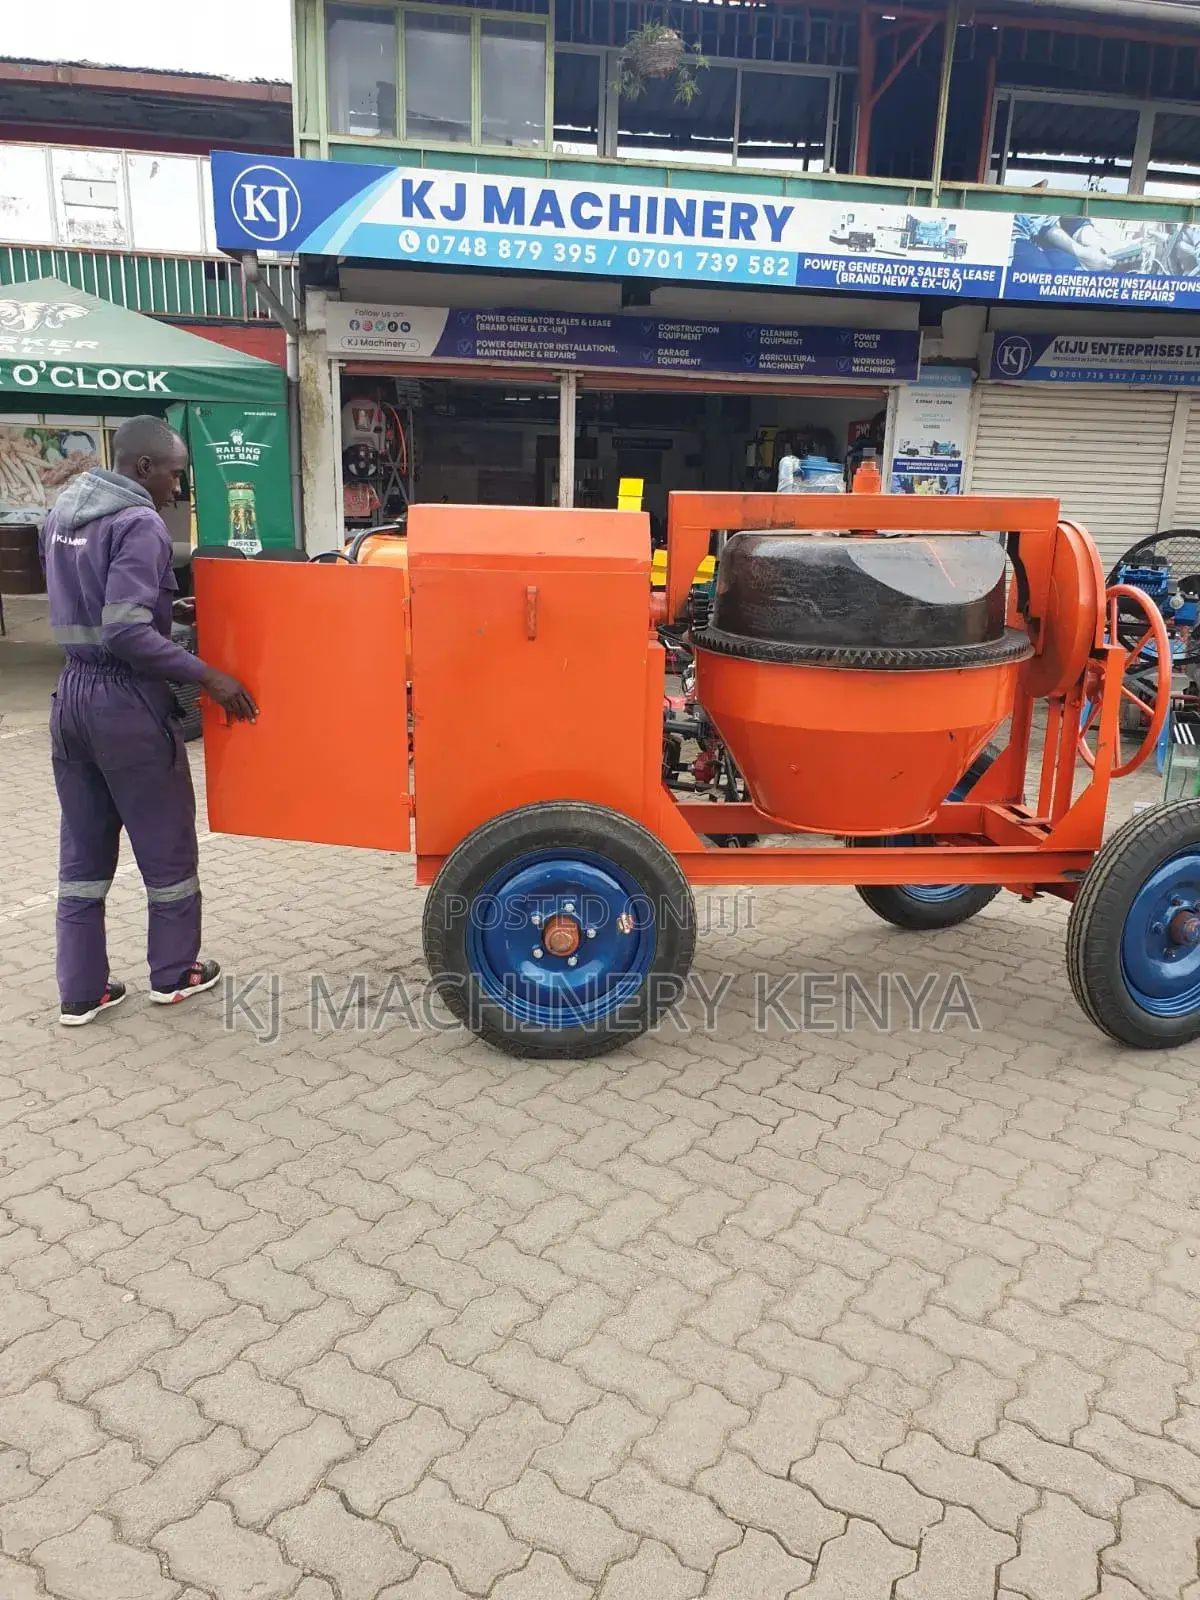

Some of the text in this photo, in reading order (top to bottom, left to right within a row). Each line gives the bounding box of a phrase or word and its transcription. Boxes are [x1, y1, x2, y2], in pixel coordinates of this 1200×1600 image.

[240, 183, 290, 241] KJ
[401, 178, 796, 243] KJ MACHINERY
[426, 235, 790, 277] 0748 879 395 / 0701 739 582
[803, 258, 996, 282] POWER GENERATOR SALES & LEASE
[836, 270, 963, 293] (BRAND NEW & EX-UK)
[1012, 271, 1053, 285] POWER
[1054, 274, 1119, 289] GENERATOR
[1039, 286, 1176, 303] MAINTENANCE & REPAIRS
[354, 308, 380, 318] Follow
[476, 314, 612, 328] POWER GENERATOR SALES & LEASE
[476, 322, 568, 336] (BRAND NEW & EX-UK)
[658, 323, 720, 334] CONSTRUCTION
[760, 329, 799, 338] CLEANING
[658, 332, 703, 341] EQUIPMENT
[759, 337, 804, 346] EQUIPMENT
[853, 332, 882, 342] POWER
[0, 336, 100, 350] SKER
[347, 338, 407, 350] KJ Machinery
[476, 340, 619, 354] POWER GENERATOR INSTALLATIONS,
[853, 340, 879, 349] TOOLS
[0, 344, 72, 356] ALT
[476, 349, 577, 360] MAINTENANCE & REPAIRS
[657, 347, 690, 357] GARAGE
[1054, 340, 1090, 355] KIJU
[1091, 341, 1185, 358] ENTERPRISES
[657, 356, 702, 366] EQUIPMENT
[758, 353, 817, 363] AGRICULTURAL
[852, 357, 897, 366] WORKSHOP
[1002, 345, 1029, 375] KJ
[758, 361, 805, 371] MACHINERY
[851, 364, 897, 374] MACHINERY
[12, 360, 171, 393] O'CLOCK
[215, 446, 261, 455] RAISING
[238, 453, 260, 462] BAR
